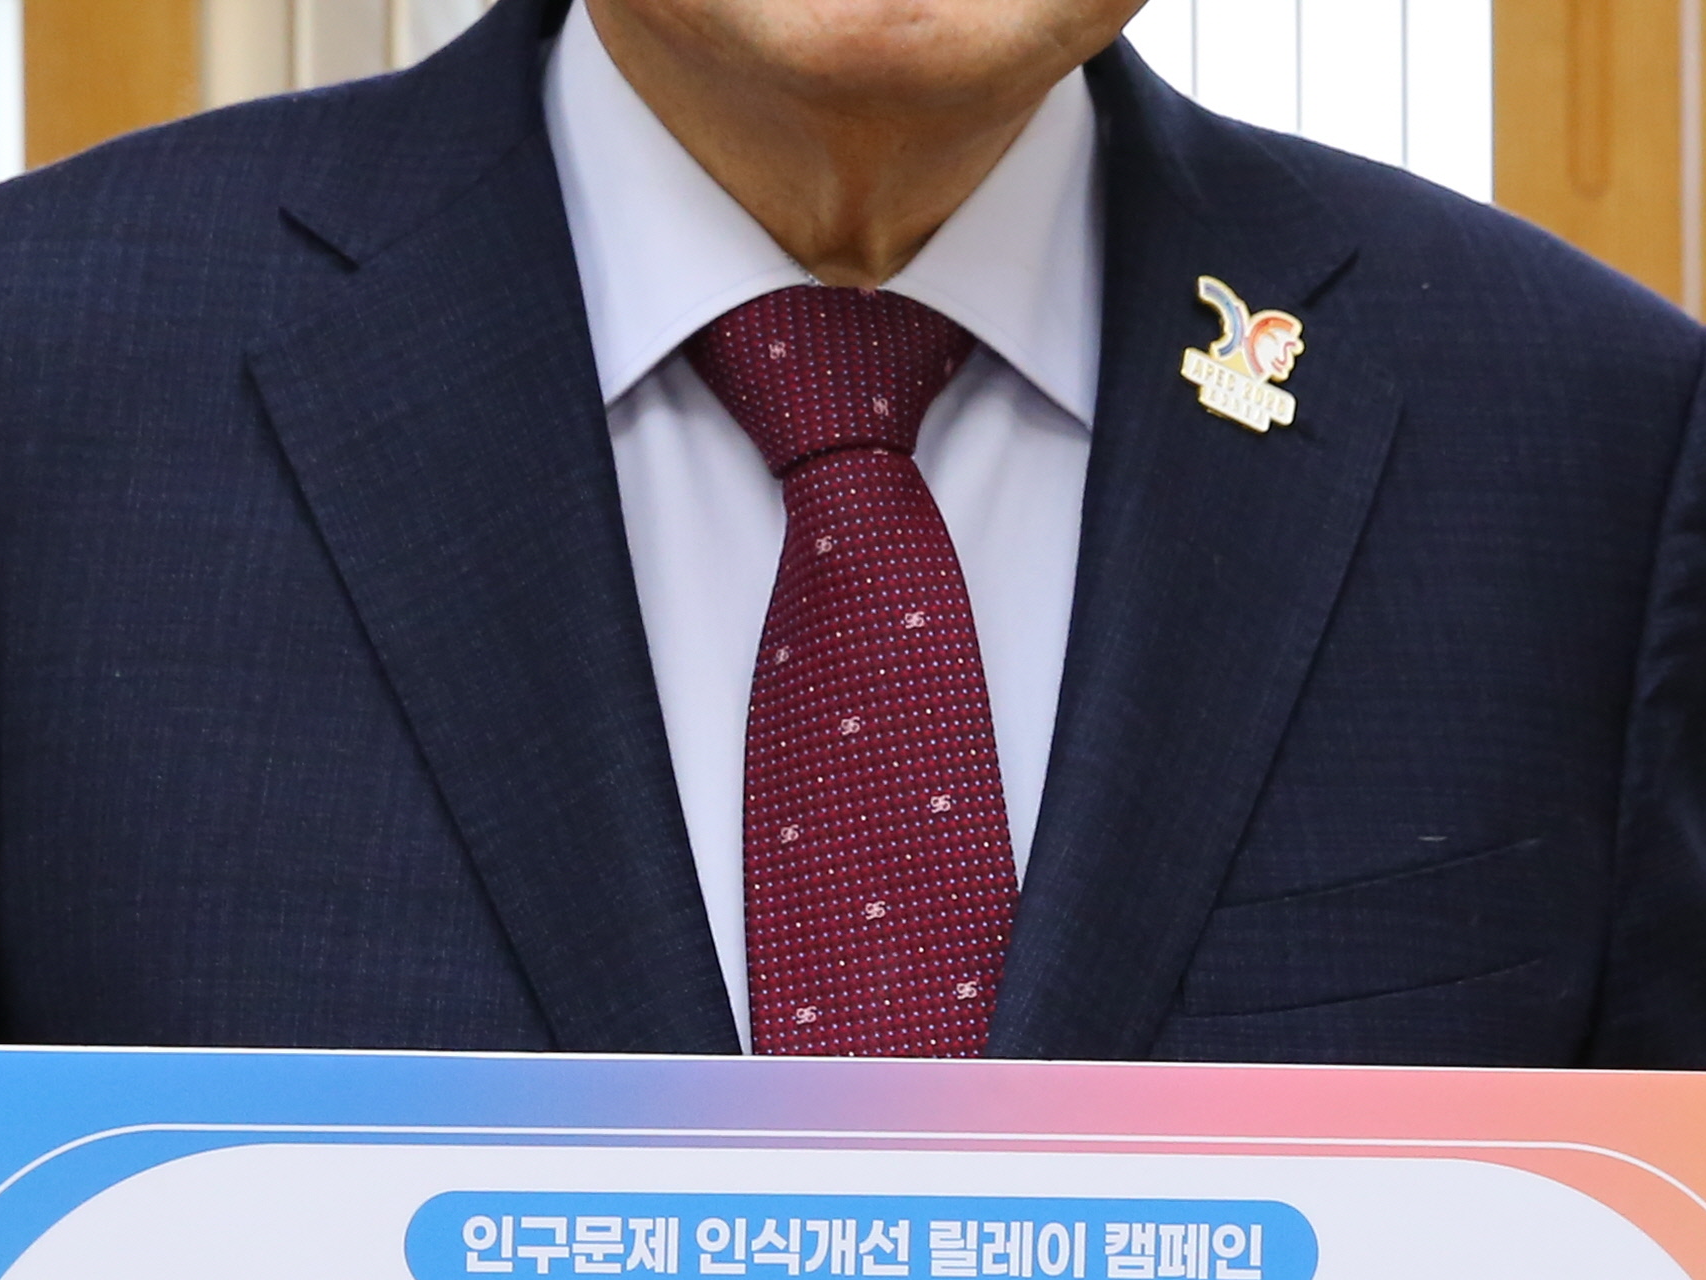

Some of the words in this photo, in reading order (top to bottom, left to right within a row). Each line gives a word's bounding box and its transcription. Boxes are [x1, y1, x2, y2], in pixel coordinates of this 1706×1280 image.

[461, 1214, 679, 1274] 인구문제
[696, 1216, 911, 1277] 인식개선
[928, 1219, 1086, 1280] 릴레이
